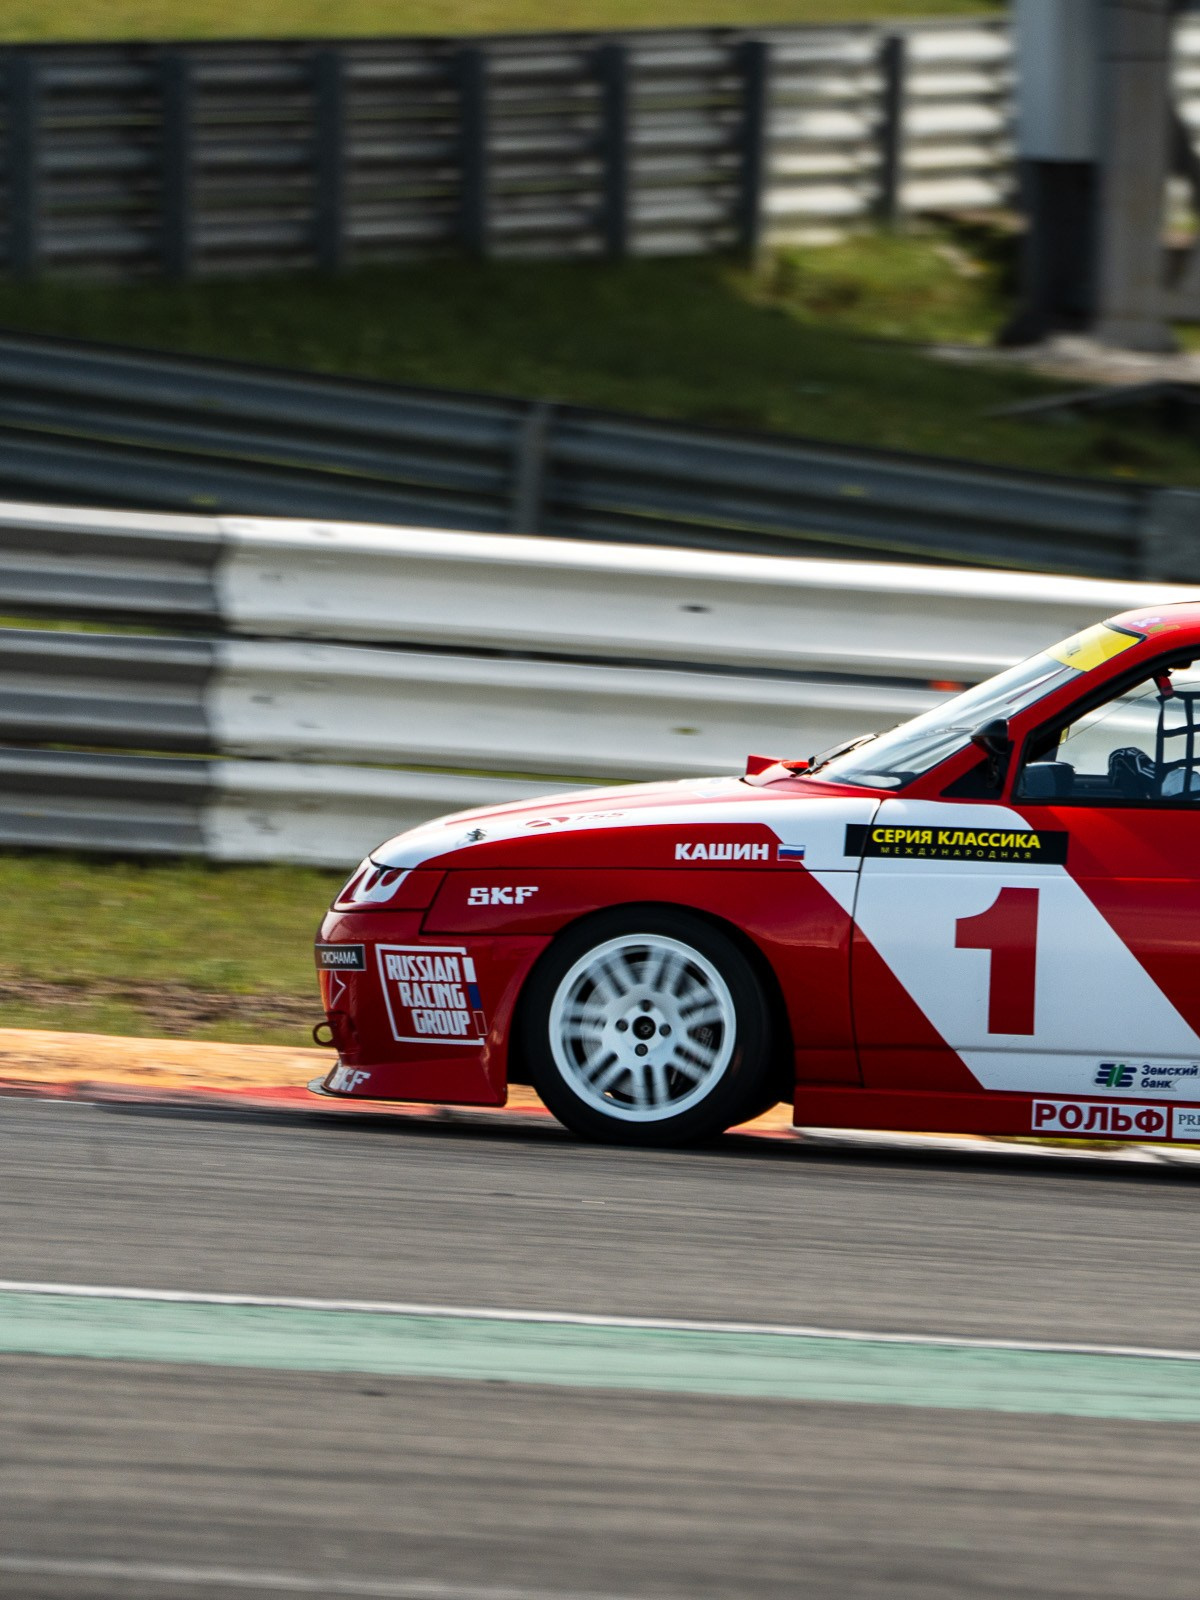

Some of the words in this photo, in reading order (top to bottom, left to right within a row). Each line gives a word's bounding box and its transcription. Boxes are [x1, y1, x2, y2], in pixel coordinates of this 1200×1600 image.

[872, 829, 932, 844] СЕРИЯ
[937, 831, 1041, 849] КЛАССИКА
[675, 843, 769, 860] КАШИН
[880, 846, 1032, 860] МЕЖДУНАРОДНАЯ
[467, 886, 539, 906] SKF
[385, 954, 461, 982] RUSSIAN
[954, 887, 1040, 1036] 1
[398, 982, 467, 1009] RACING
[411, 1009, 471, 1035] GROUP
[1141, 1064, 1199, 1077] Земский
[1141, 1077, 1172, 1089] банк
[1035, 1103, 1165, 1134] РОЛЬФ
